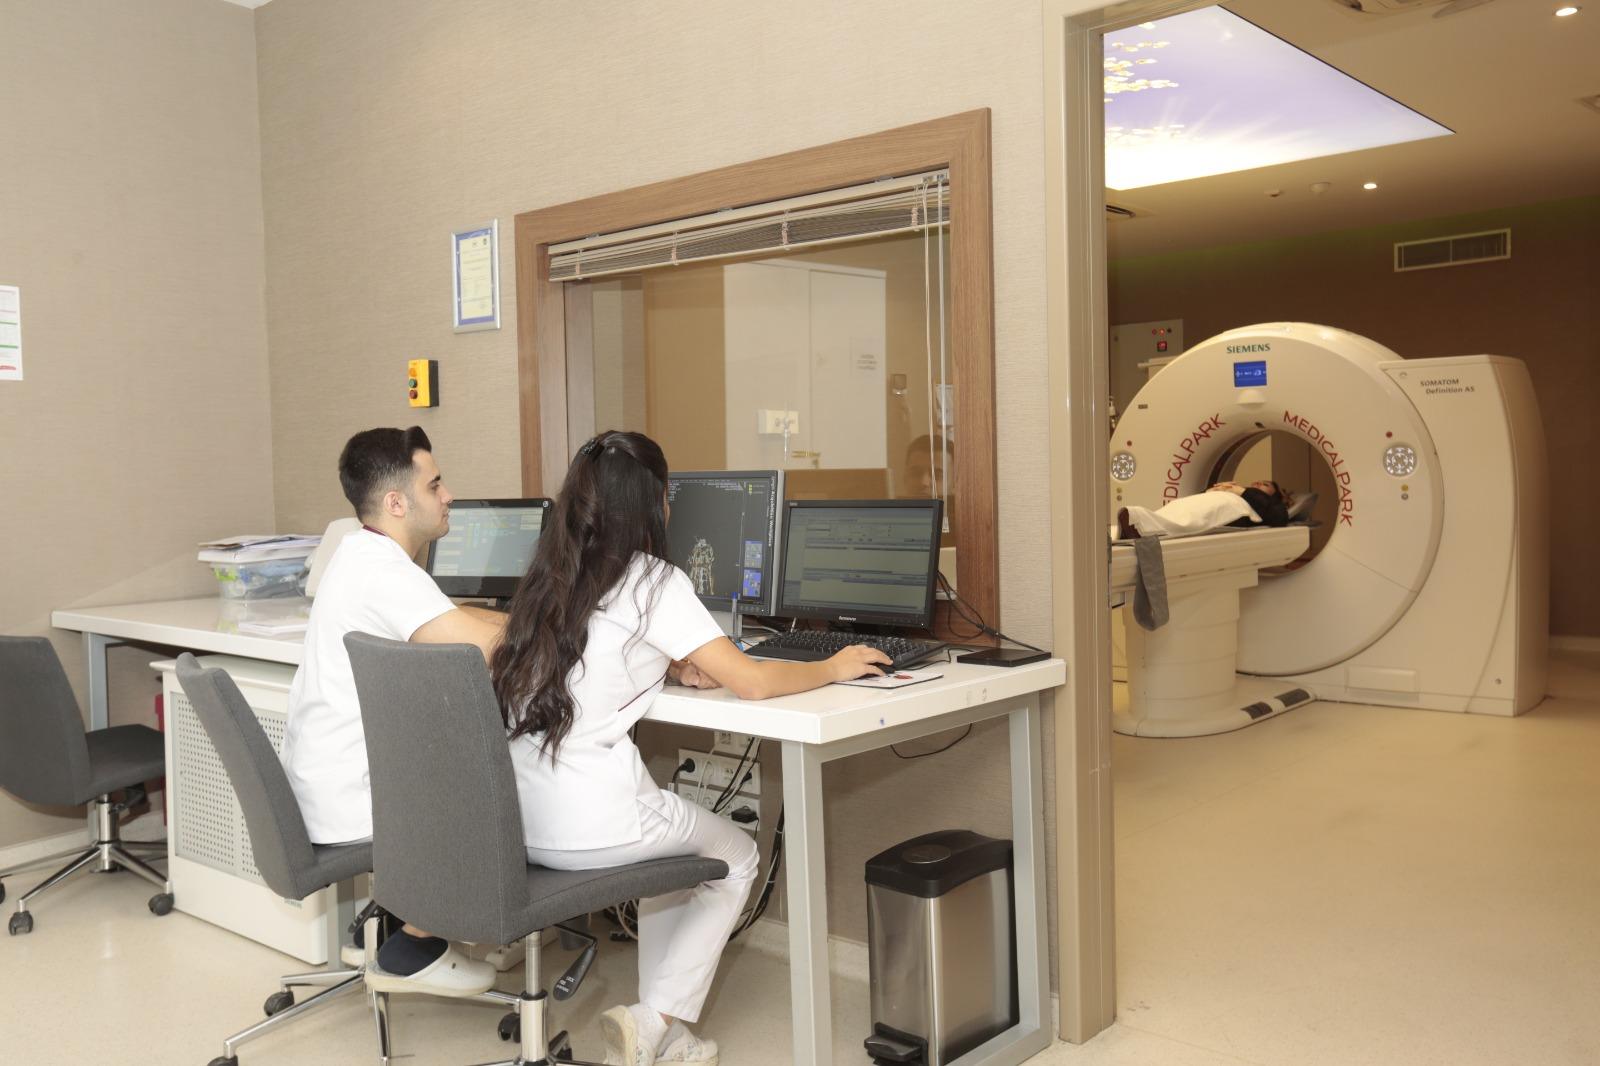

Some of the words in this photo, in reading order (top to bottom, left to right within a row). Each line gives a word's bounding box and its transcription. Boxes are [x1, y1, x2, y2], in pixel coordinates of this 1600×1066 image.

[1226, 343, 1271, 354] SIEMENS
[1420, 378, 1459, 387] SOMATOM
[1425, 386, 1463, 394] Definition
[1162, 412, 1227, 506] DICALPARK
[1283, 410, 1353, 527] MEDICALPARK
